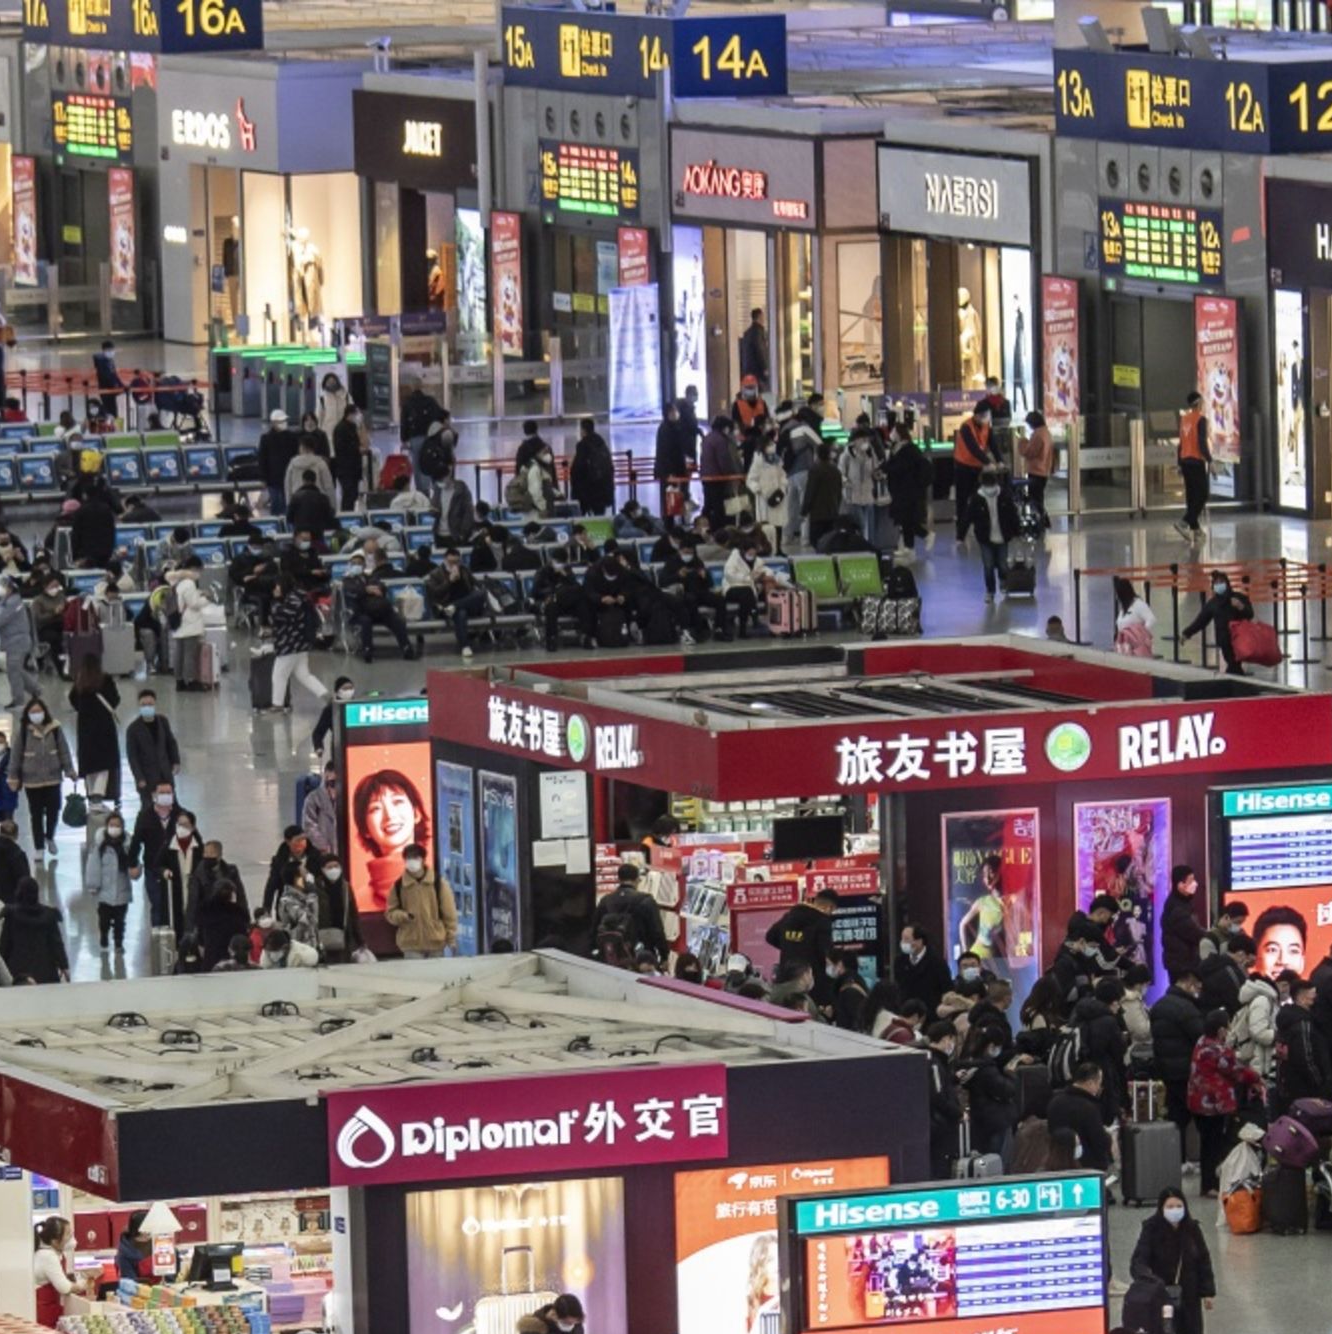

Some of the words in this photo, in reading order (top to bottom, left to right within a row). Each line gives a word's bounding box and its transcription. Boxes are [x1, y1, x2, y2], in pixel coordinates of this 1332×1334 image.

[132, 0, 158, 36] 16A
[177, 0, 245, 35] 16A
[505, 26, 534, 69] 15A
[581, 31, 613, 58] 检票口
[640, 34, 669, 79] 14A
[692, 34, 769, 79] 14A
[1058, 69, 1094, 119] 13A
[1151, 75, 1191, 107] 检票口
[1225, 82, 1264, 133] 12A
[172, 109, 231, 149] ERDOS
[1152, 110, 1174, 127] Check
[683, 160, 741, 197] AOKANG
[488, 695, 563, 757] 旅友书屋
[836, 727, 1029, 786] 旅友书屋
[1236, 792, 1330, 812] Hisense
[584, 1094, 724, 1145] 外交官
[815, 1199, 939, 1227] Hisense
[996, 1188, 1030, 1209] 6-30
